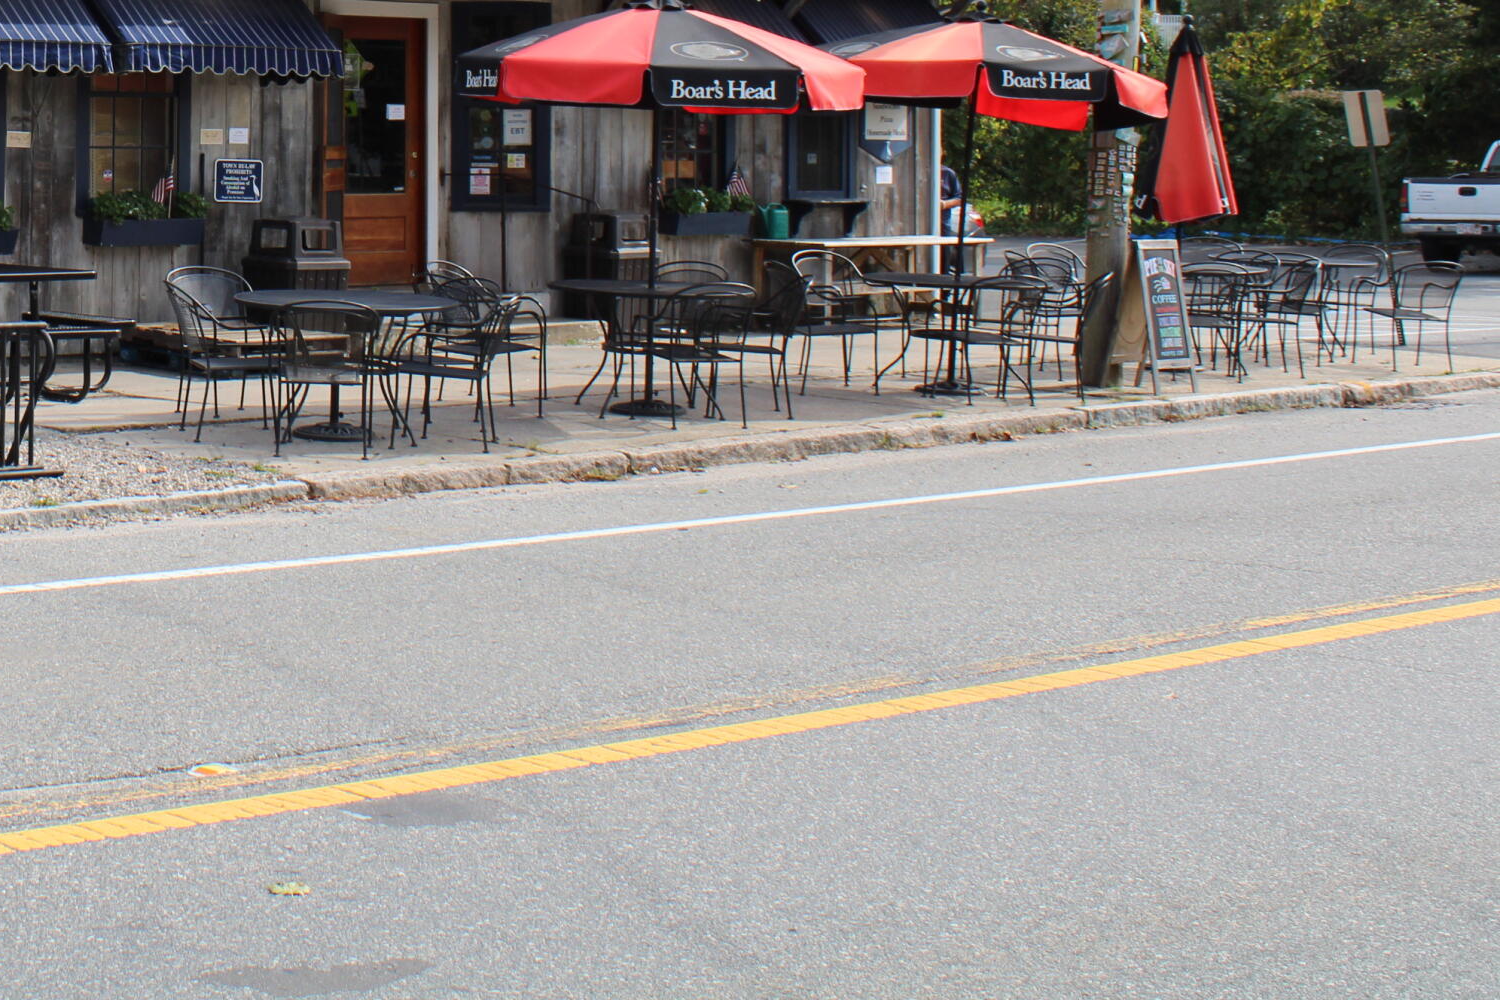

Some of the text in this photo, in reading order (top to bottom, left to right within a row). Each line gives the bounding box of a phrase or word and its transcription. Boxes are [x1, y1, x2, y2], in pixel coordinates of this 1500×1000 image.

[670, 79, 776, 101] Boar's Head
[1002, 69, 1091, 91] Boar's Head
